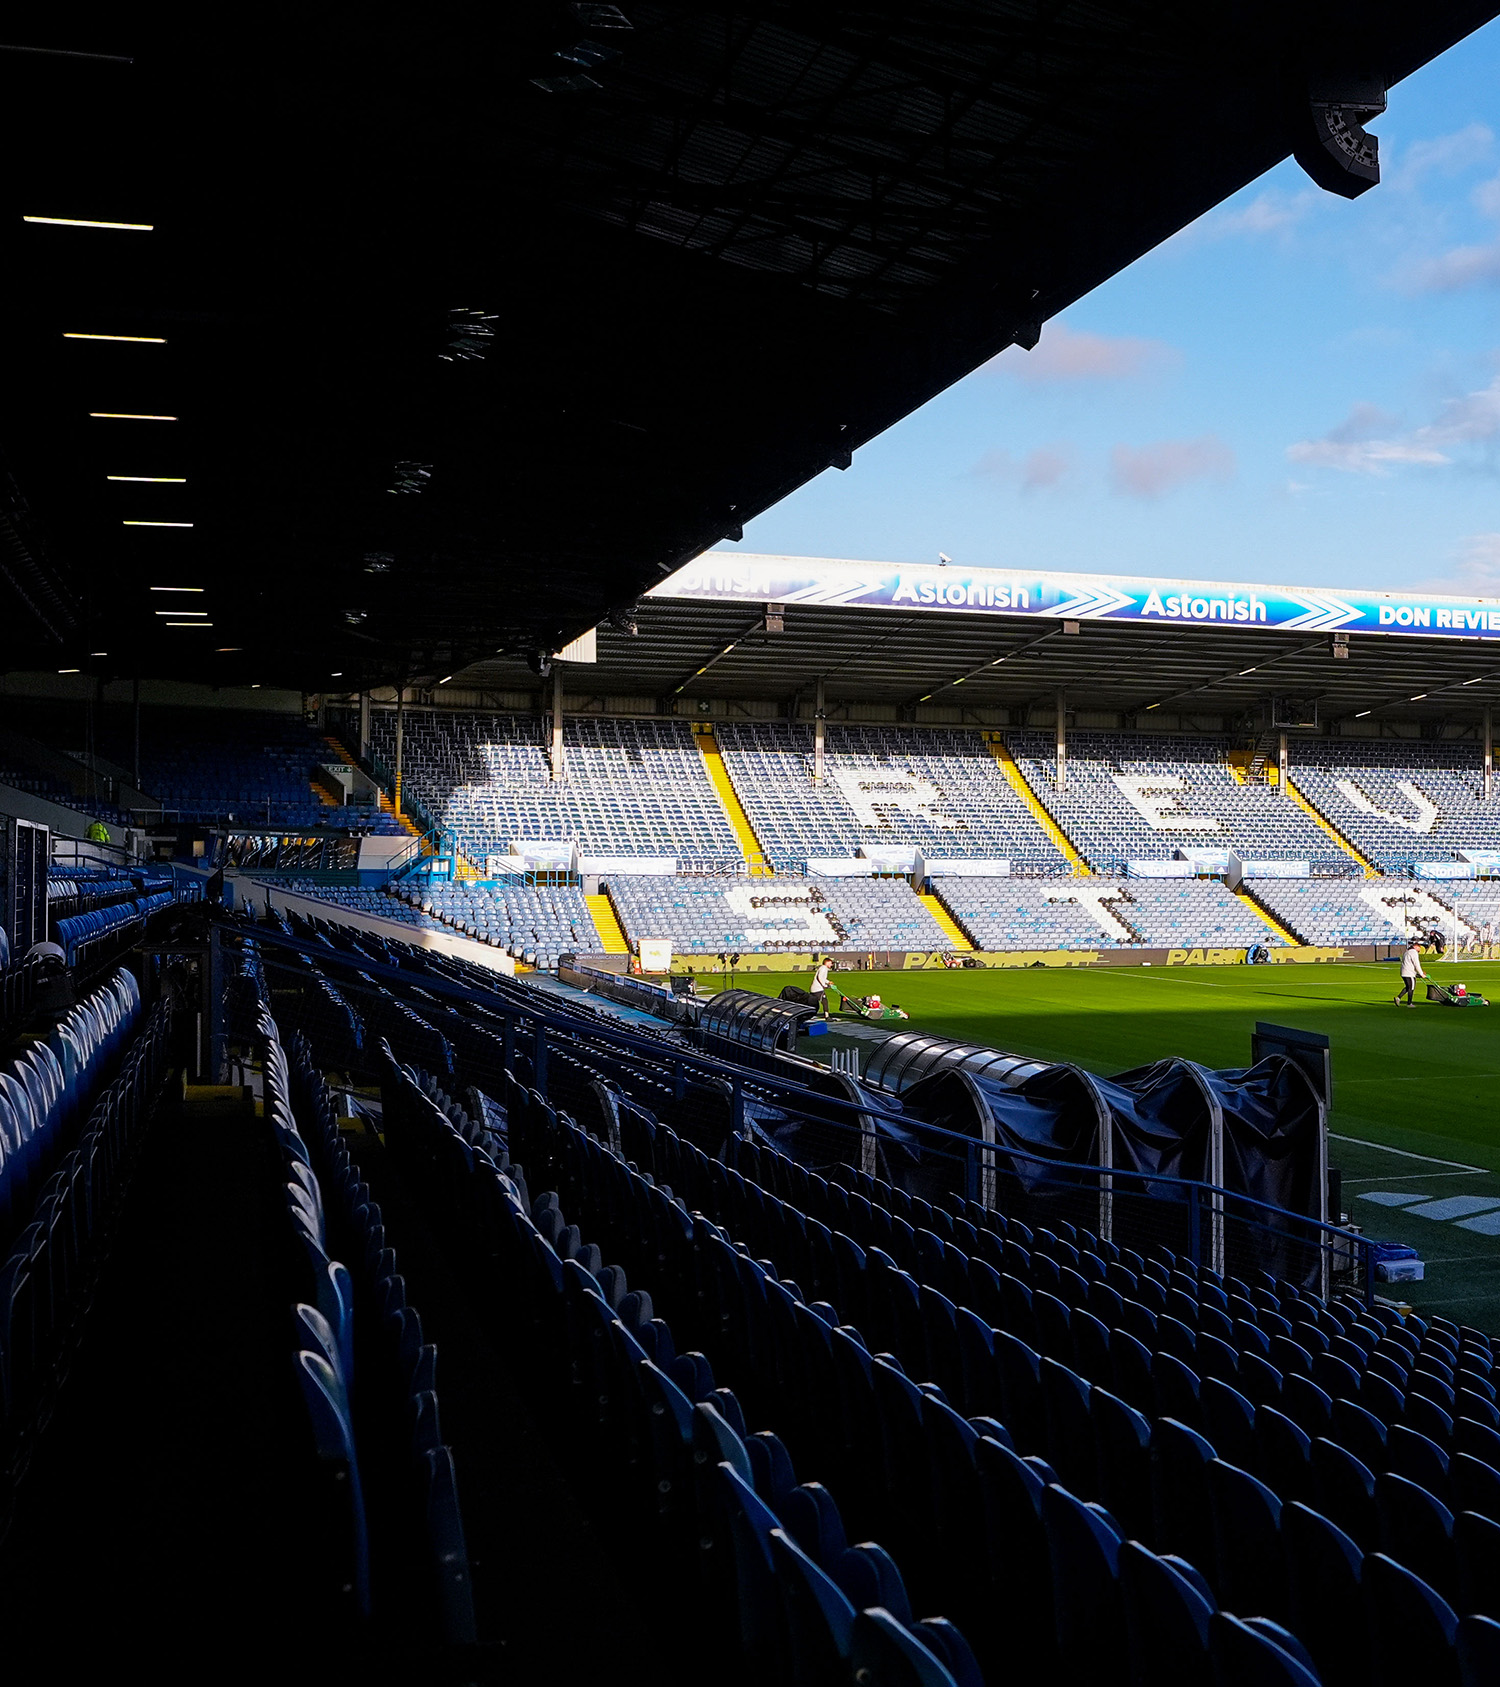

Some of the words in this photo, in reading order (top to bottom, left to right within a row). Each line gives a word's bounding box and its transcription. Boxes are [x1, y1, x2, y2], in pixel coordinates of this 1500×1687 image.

[891, 578, 1029, 609] Astonish
[1140, 587, 1266, 622] Astonish
[1379, 605, 1430, 627] DON
[1437, 608, 1500, 631] REVIE
[1420, 864, 1471, 877] Astonish
